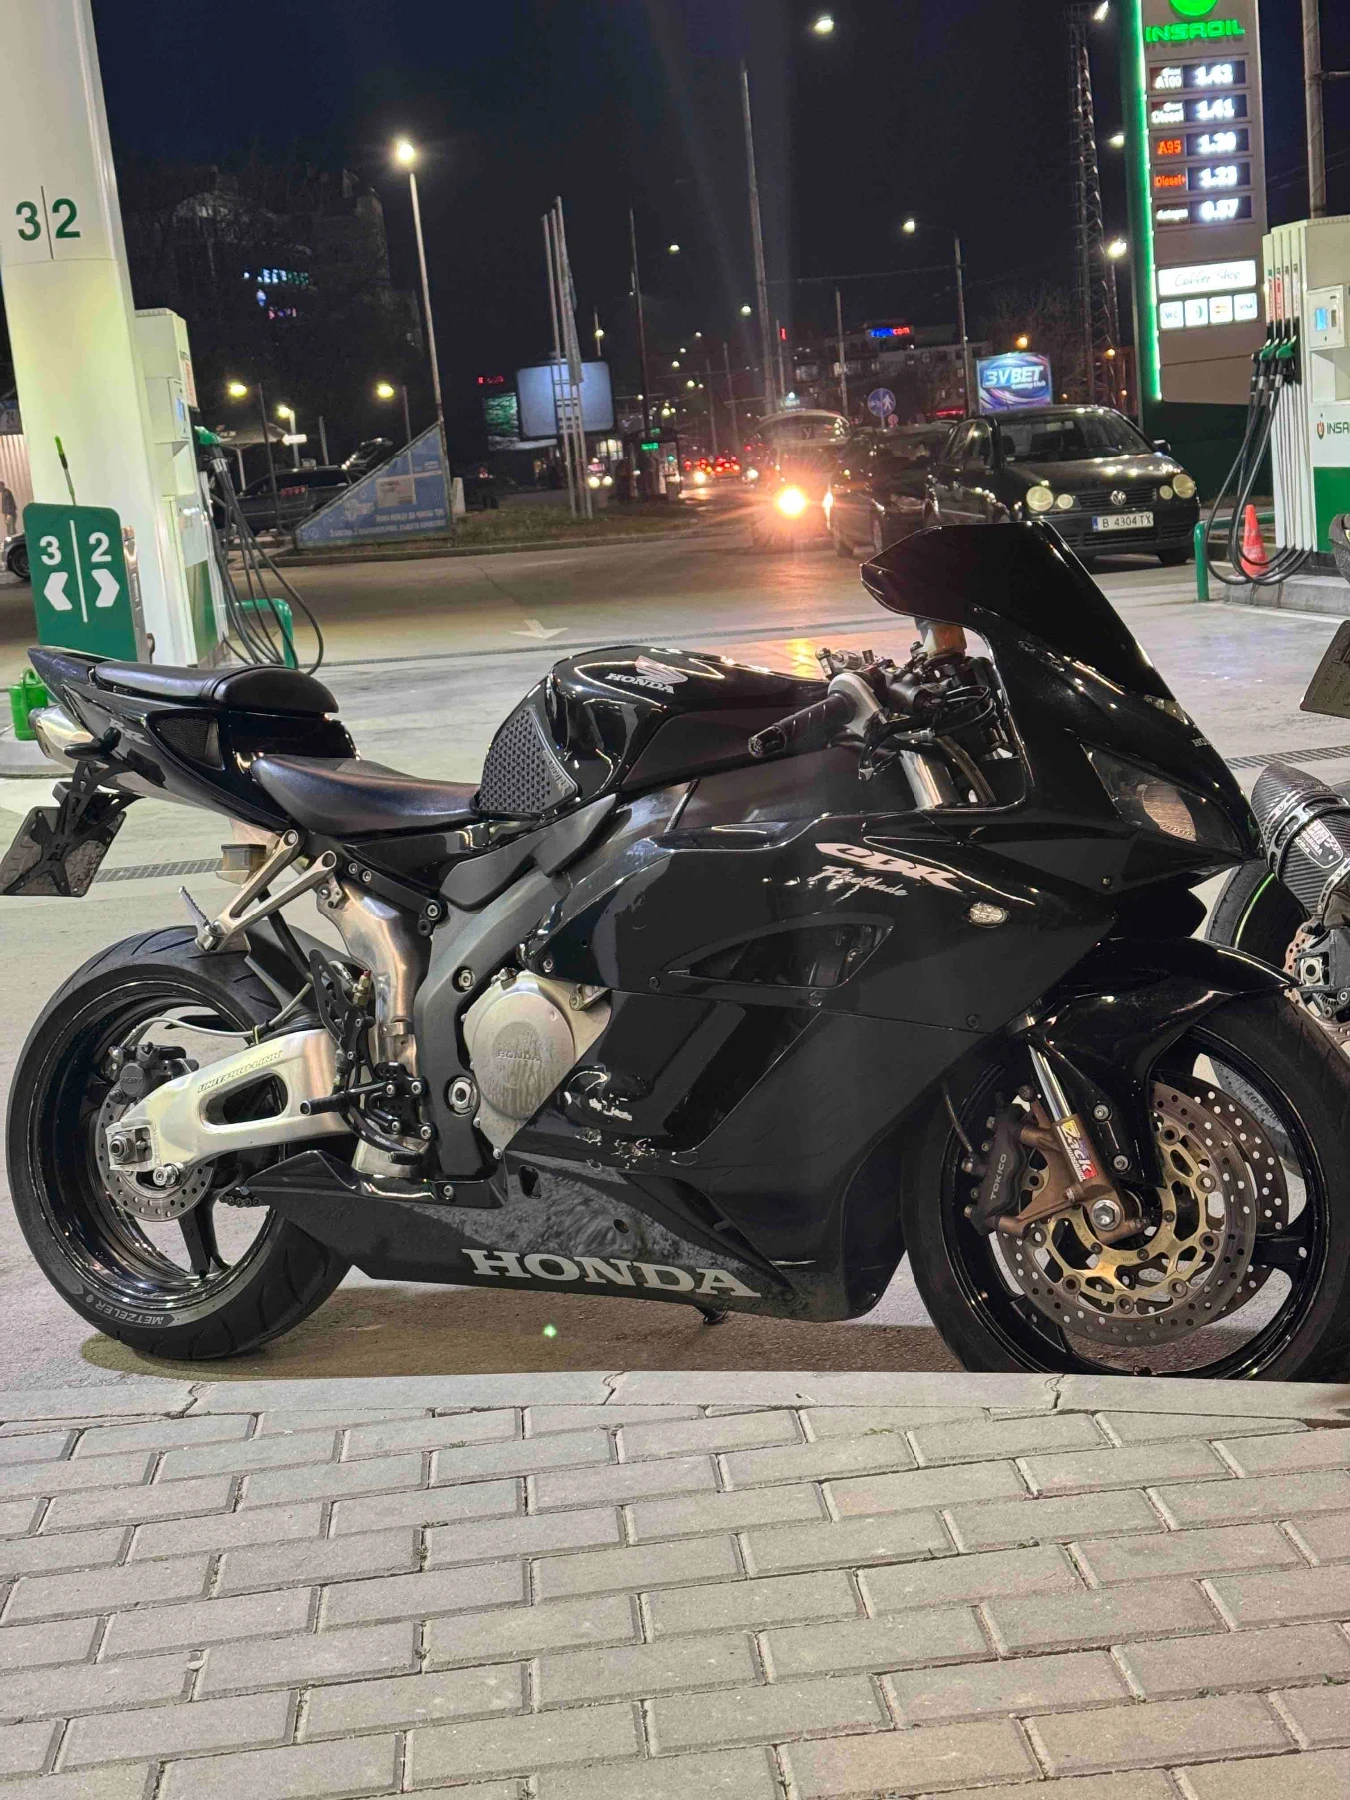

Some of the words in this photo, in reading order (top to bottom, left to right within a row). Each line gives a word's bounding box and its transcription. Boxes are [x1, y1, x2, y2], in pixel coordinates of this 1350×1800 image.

[1157, 139, 1182, 155] A95
[16, 201, 41, 241] 3
[52, 198, 81, 239] 2
[1164, 310, 1178, 319] WC
[984, 366, 1045, 386] 3VBET
[1102, 518, 1110, 529] B
[1114, 516, 1137, 527] 4304
[39, 535, 62, 566] 3
[88, 532, 112, 563] 2
[605, 673, 675, 694] HONDA
[815, 843, 964, 893] CBR
[990, 1153, 1007, 1200] TOKICO
[461, 1248, 762, 1298] HONDA
[95, 1299, 165, 1325] METZELER
